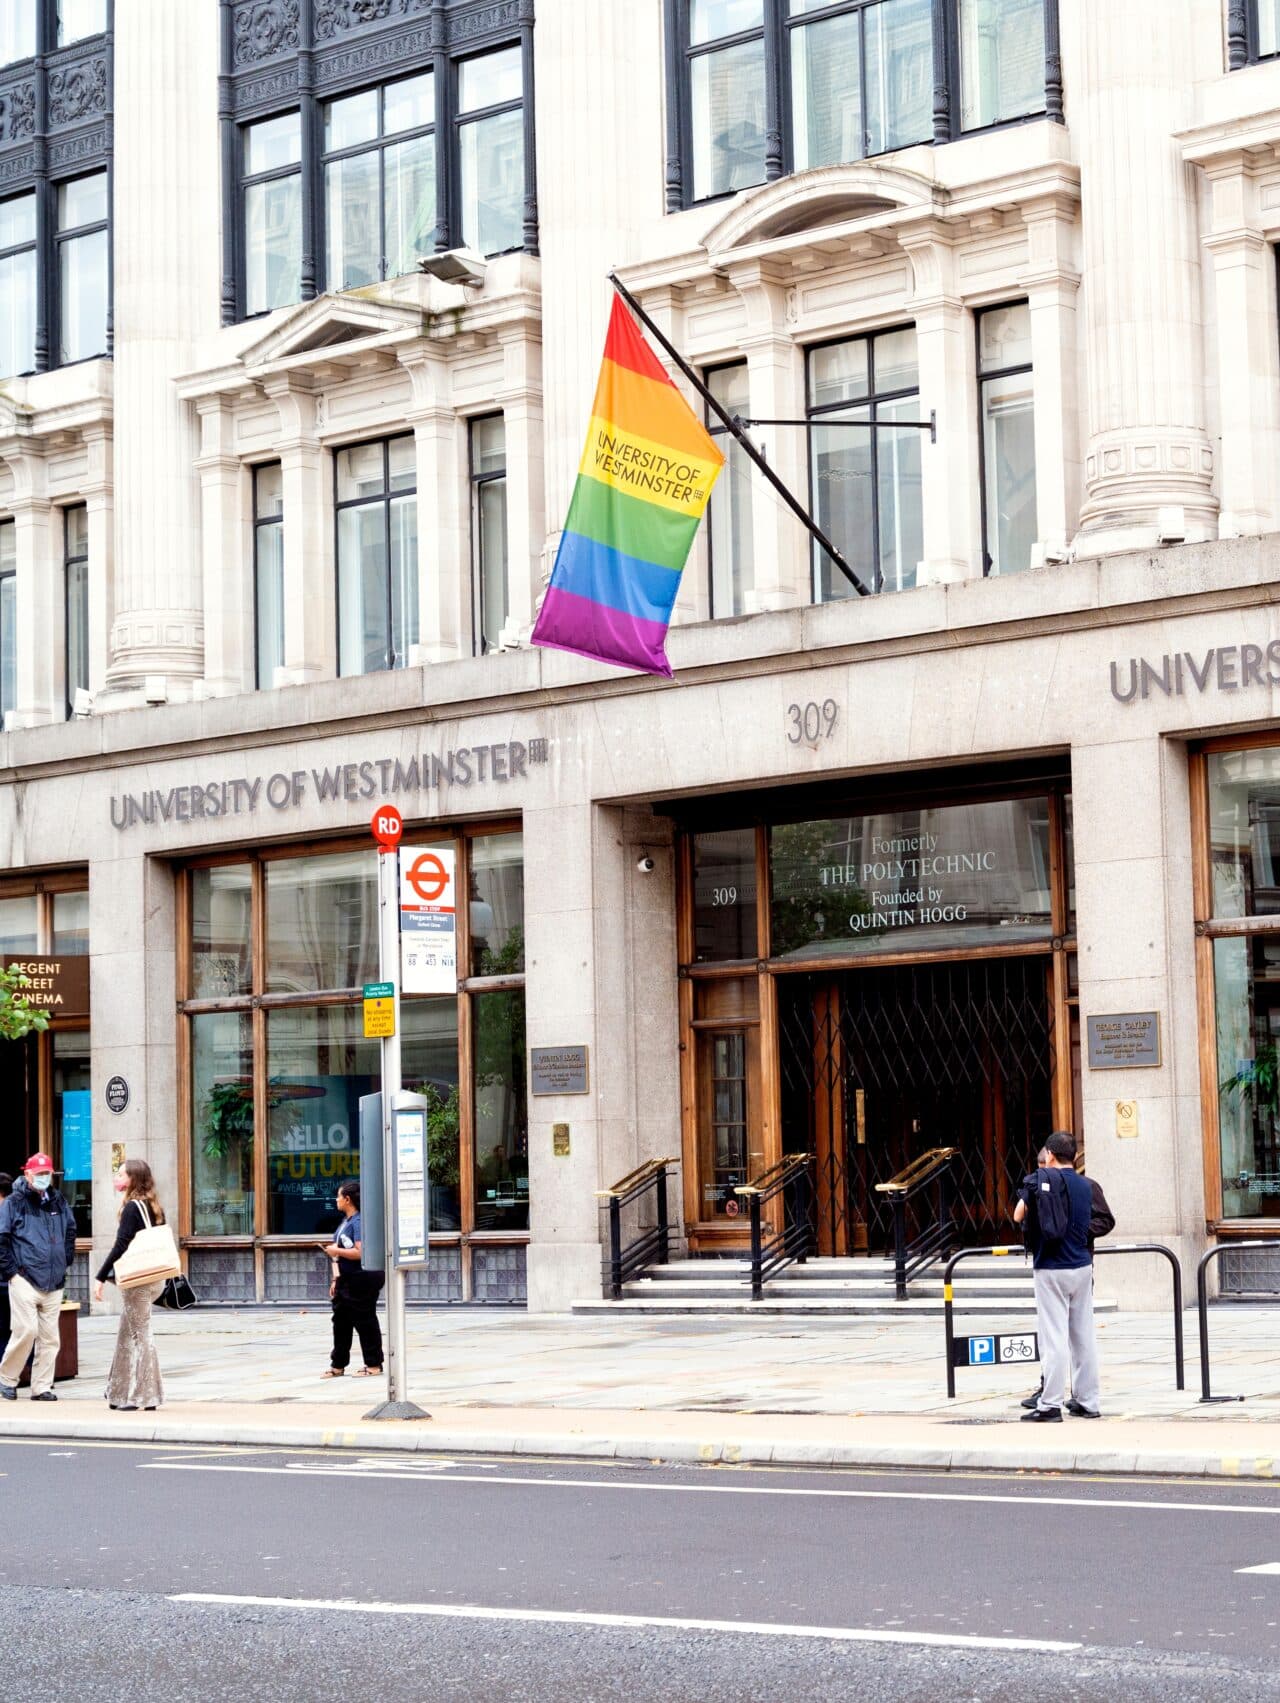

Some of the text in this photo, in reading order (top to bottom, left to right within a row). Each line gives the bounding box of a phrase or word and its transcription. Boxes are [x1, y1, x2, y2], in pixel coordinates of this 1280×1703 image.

[676, 465, 701, 484] OF
[787, 698, 837, 744] 309
[110, 740, 527, 829] UNIVERSITY OF WESTMINSTER
[378, 816, 400, 834] RD
[871, 832, 938, 855] Formerly
[819, 851, 996, 886] THE POLYTECHNIC
[711, 886, 737, 907] 309
[871, 886, 943, 906] Founded by
[849, 905, 968, 932] QUINTIN HOGG
[14, 978, 54, 989] REET
[12, 992, 64, 1005] CINEMA
[276, 1151, 360, 1179] FUTURE
[973, 1339, 990, 1362] P
